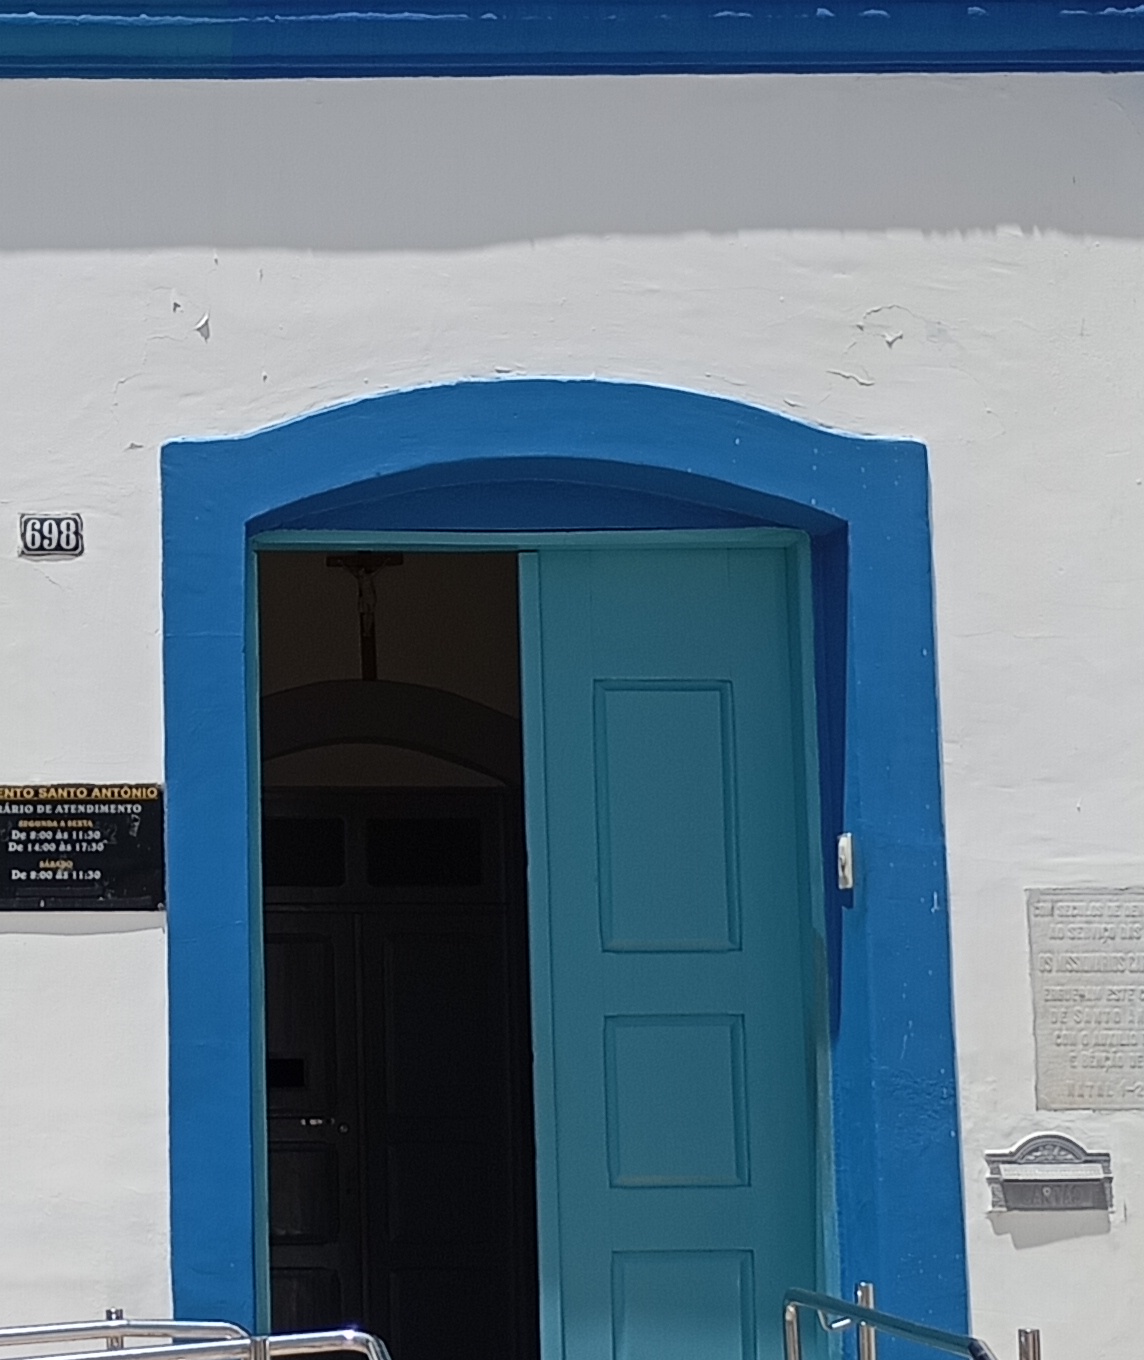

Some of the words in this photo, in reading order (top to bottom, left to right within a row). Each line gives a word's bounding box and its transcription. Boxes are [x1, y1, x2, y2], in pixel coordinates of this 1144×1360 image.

[25, 519, 76, 550] 698
[38, 787, 88, 799] SANTO
[91, 785, 158, 799] ANTÔNIO
[37, 804, 53, 814] DE
[55, 804, 142, 814] ATENDIMENTO
[18, 819, 58, 828] SEGUNDA
[67, 819, 93, 828] SEXTA
[11, 829, 27, 840] De
[29, 830, 53, 840] 8:00
[72, 830, 101, 840] 11:30
[8, 842, 24, 852] De
[27, 842, 57, 852] 14:00
[75, 842, 105, 852] 17:30
[11, 869, 27, 880] De
[29, 870, 53, 880] 8:00
[72, 870, 101, 880] 11:30
[1073, 1006, 1121, 1024] SANTO
